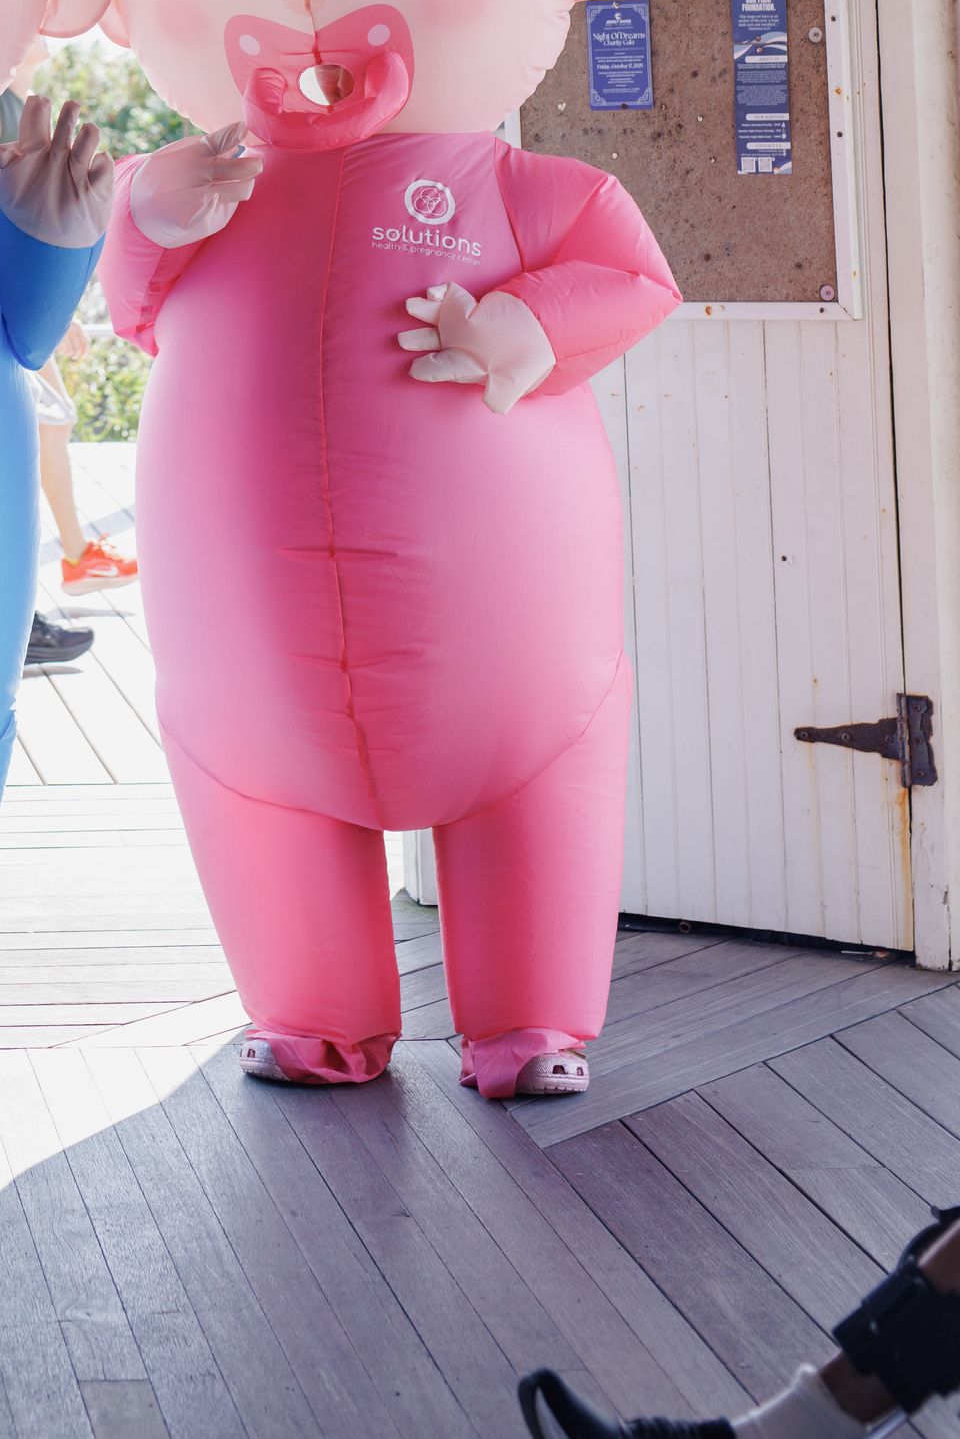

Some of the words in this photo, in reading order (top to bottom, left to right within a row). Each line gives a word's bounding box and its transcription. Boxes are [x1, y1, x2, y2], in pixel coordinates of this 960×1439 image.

[592, 32, 610, 43] Night
[620, 31, 646, 40] Dreams
[372, 224, 481, 257] solutions
[372, 241, 400, 250] health
[410, 246, 455, 259] pregnancy
[458, 255, 481, 266] center
